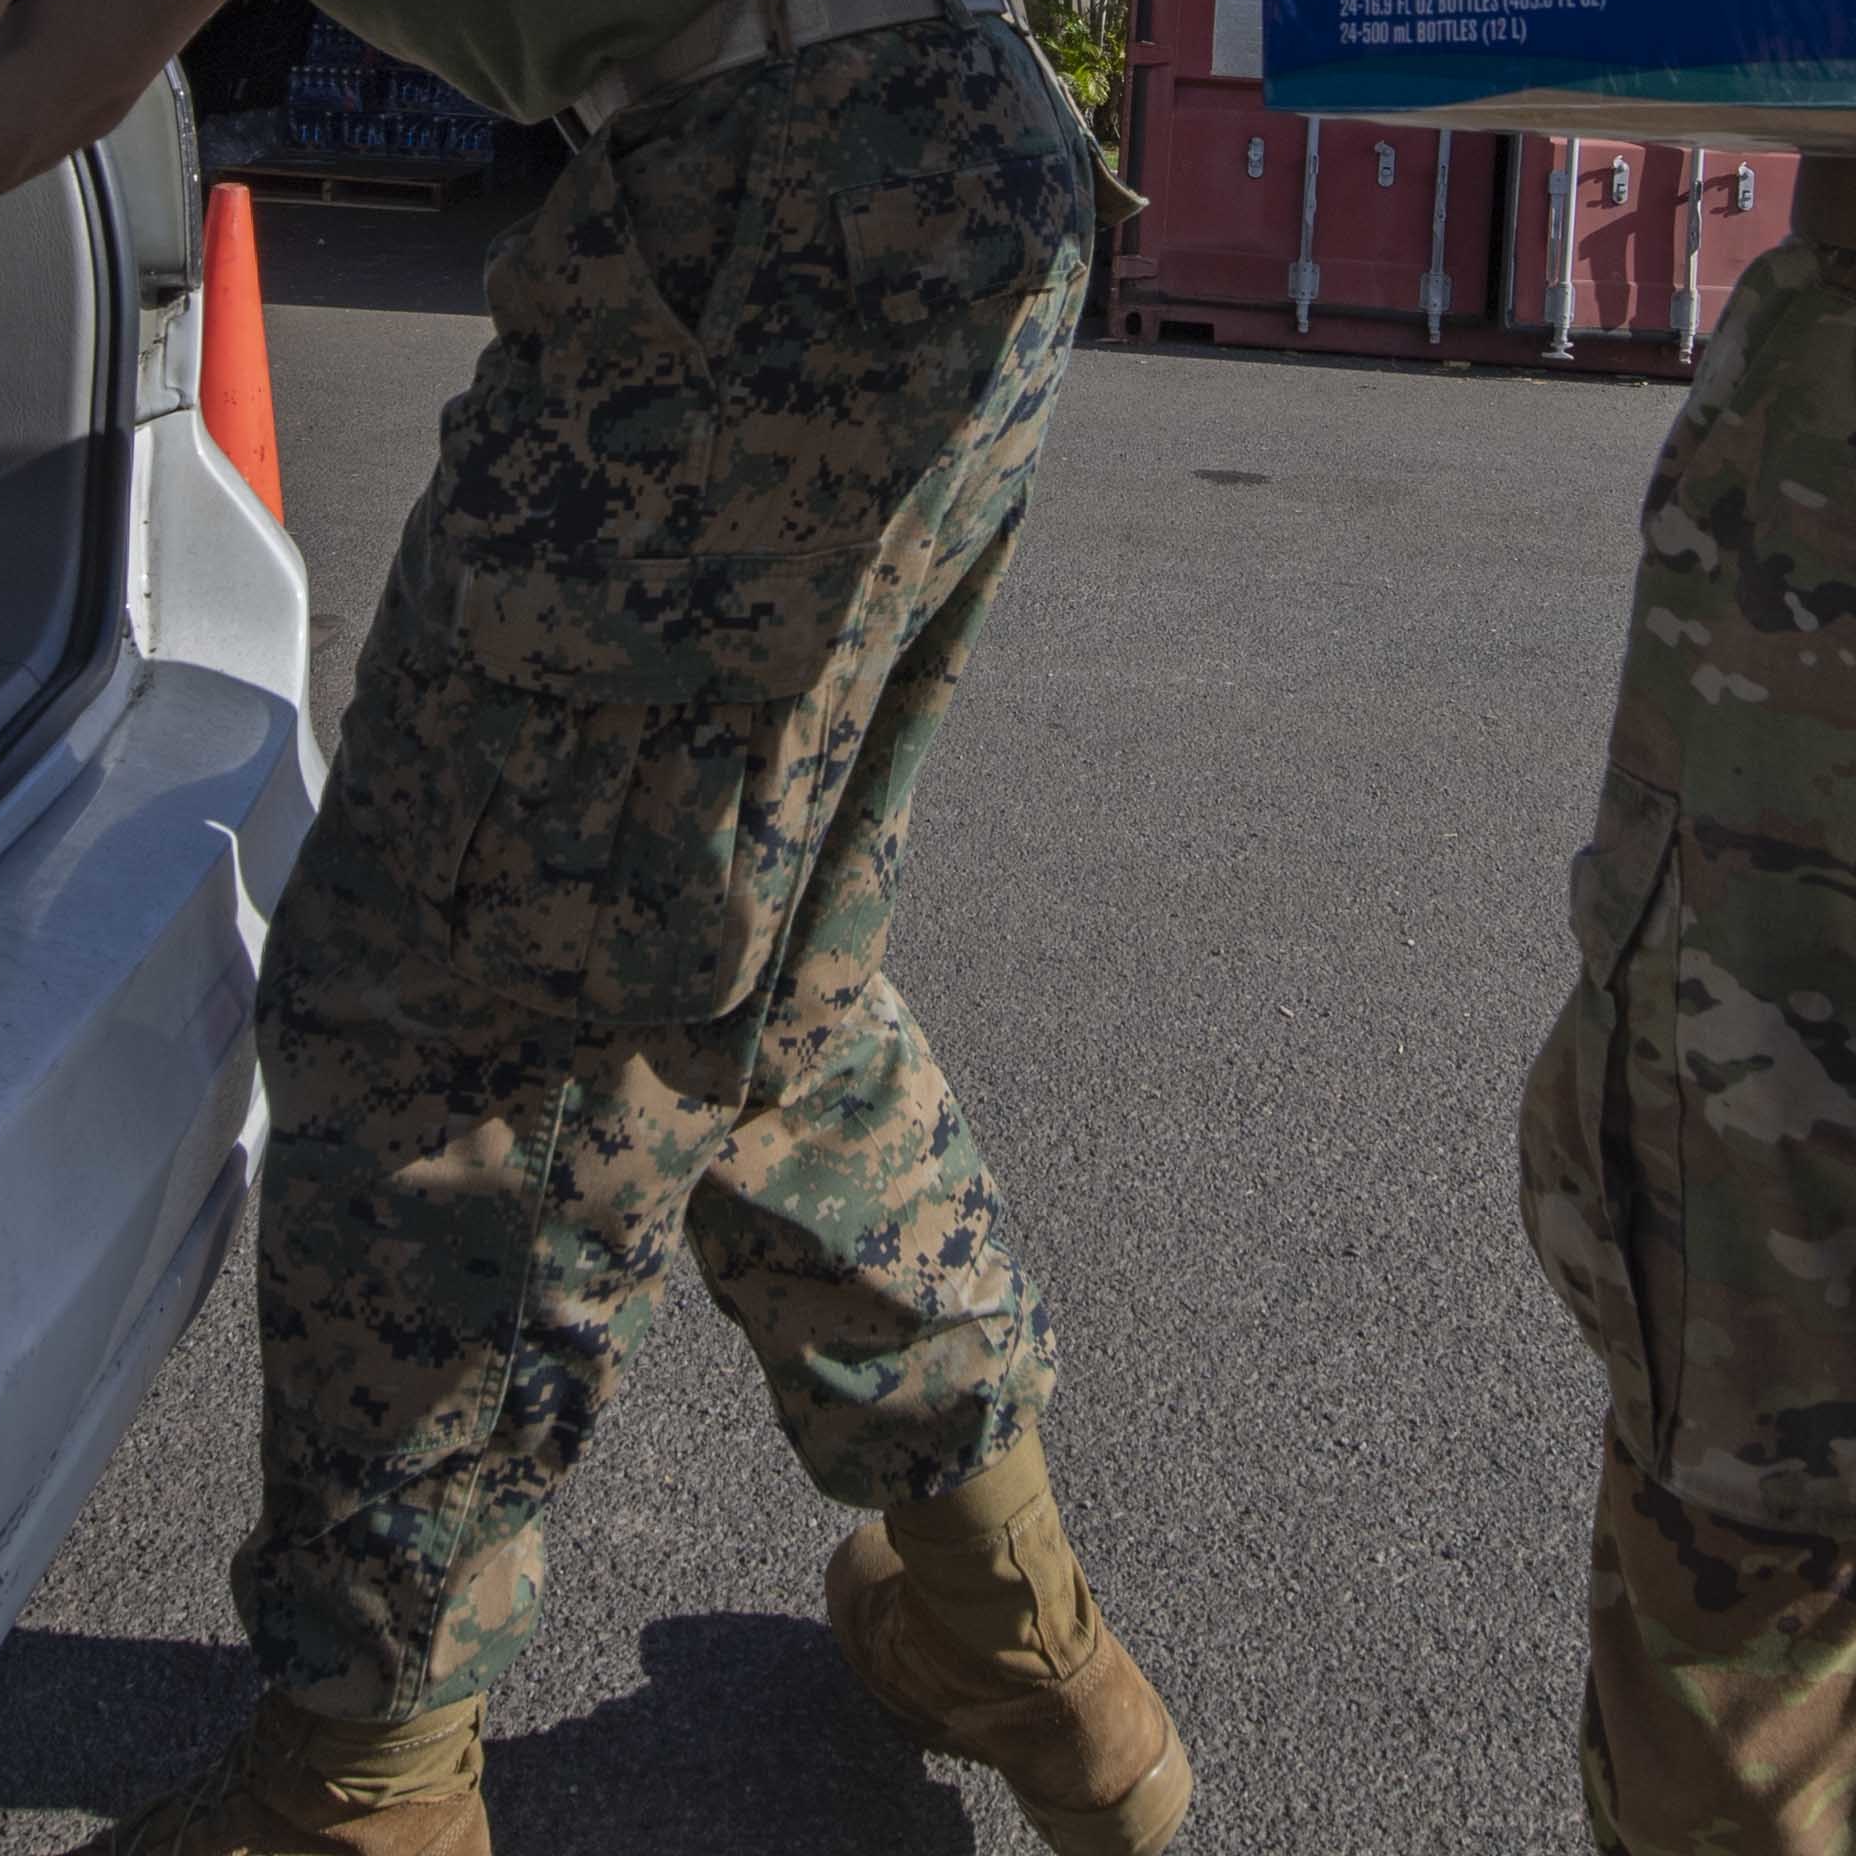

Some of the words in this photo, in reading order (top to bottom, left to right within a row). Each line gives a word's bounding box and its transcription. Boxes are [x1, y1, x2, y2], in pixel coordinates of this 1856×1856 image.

[1339, 20, 1389, 44] 24-500
[1393, 20, 1413, 43] mL
[1416, 18, 1478, 42] BOTTLES
[1482, 17, 1507, 47] (12
[1511, 16, 1528, 44] L)
